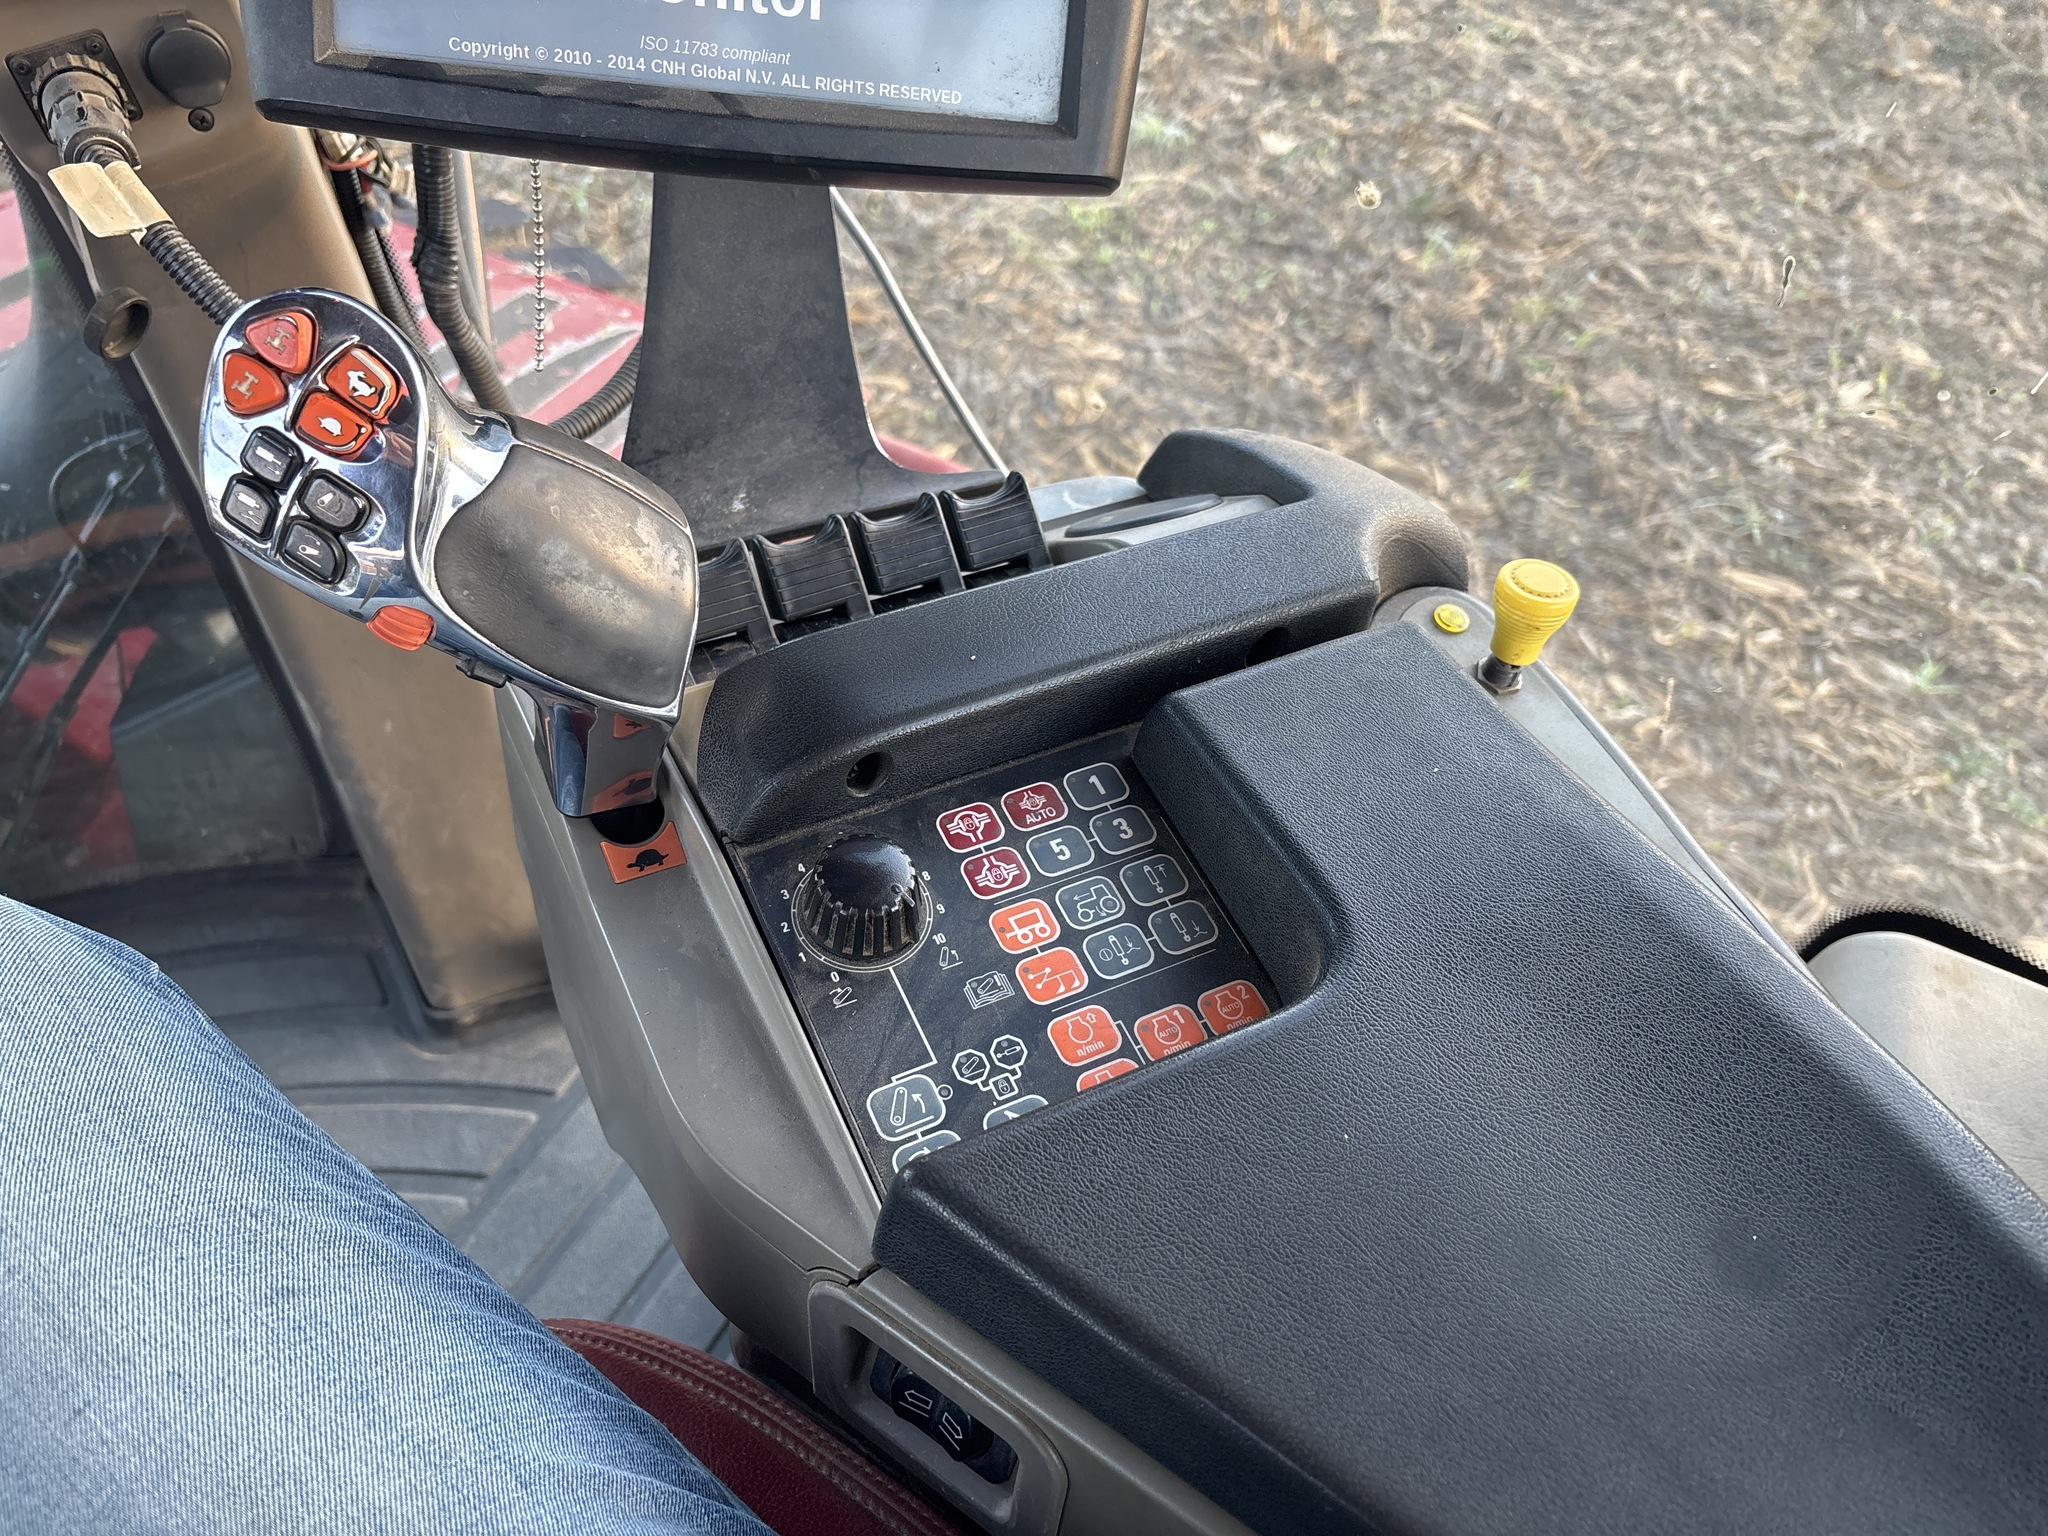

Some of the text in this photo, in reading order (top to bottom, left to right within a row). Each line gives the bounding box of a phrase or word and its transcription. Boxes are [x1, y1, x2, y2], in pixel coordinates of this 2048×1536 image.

[640, 35, 791, 64] ISO 11783 compliant
[448, 37, 530, 60] Copyright
[553, 48, 592, 66] 2010
[607, 54, 647, 72] 2014
[651, 59, 686, 76] CNH
[691, 64, 741, 82] Global
[745, 69, 776, 86] N.V.
[781, 73, 811, 90] ALL
[815, 76, 875, 95] RIGHTS
[879, 83, 962, 105] RESERVED
[1088, 774, 1106, 795] 1
[1025, 806, 1056, 824] AUTO
[1112, 818, 1133, 839] 3
[1049, 838, 1070, 860] 5
[797, 863, 806, 873] 4
[921, 871, 931, 881] 8
[780, 889, 790, 900] 3
[936, 903, 946, 914] 9
[780, 922, 791, 933] 2
[932, 932, 946, 944] 10
[798, 952, 807, 962] 1
[830, 971, 840, 983] 0
[1236, 984, 1249, 999] 2
[1221, 1002, 1239, 1013] AUTO
[1172, 1009, 1184, 1023] 1
[1159, 1026, 1177, 1038] AUTO
[1076, 1040, 1104, 1056] n/min
